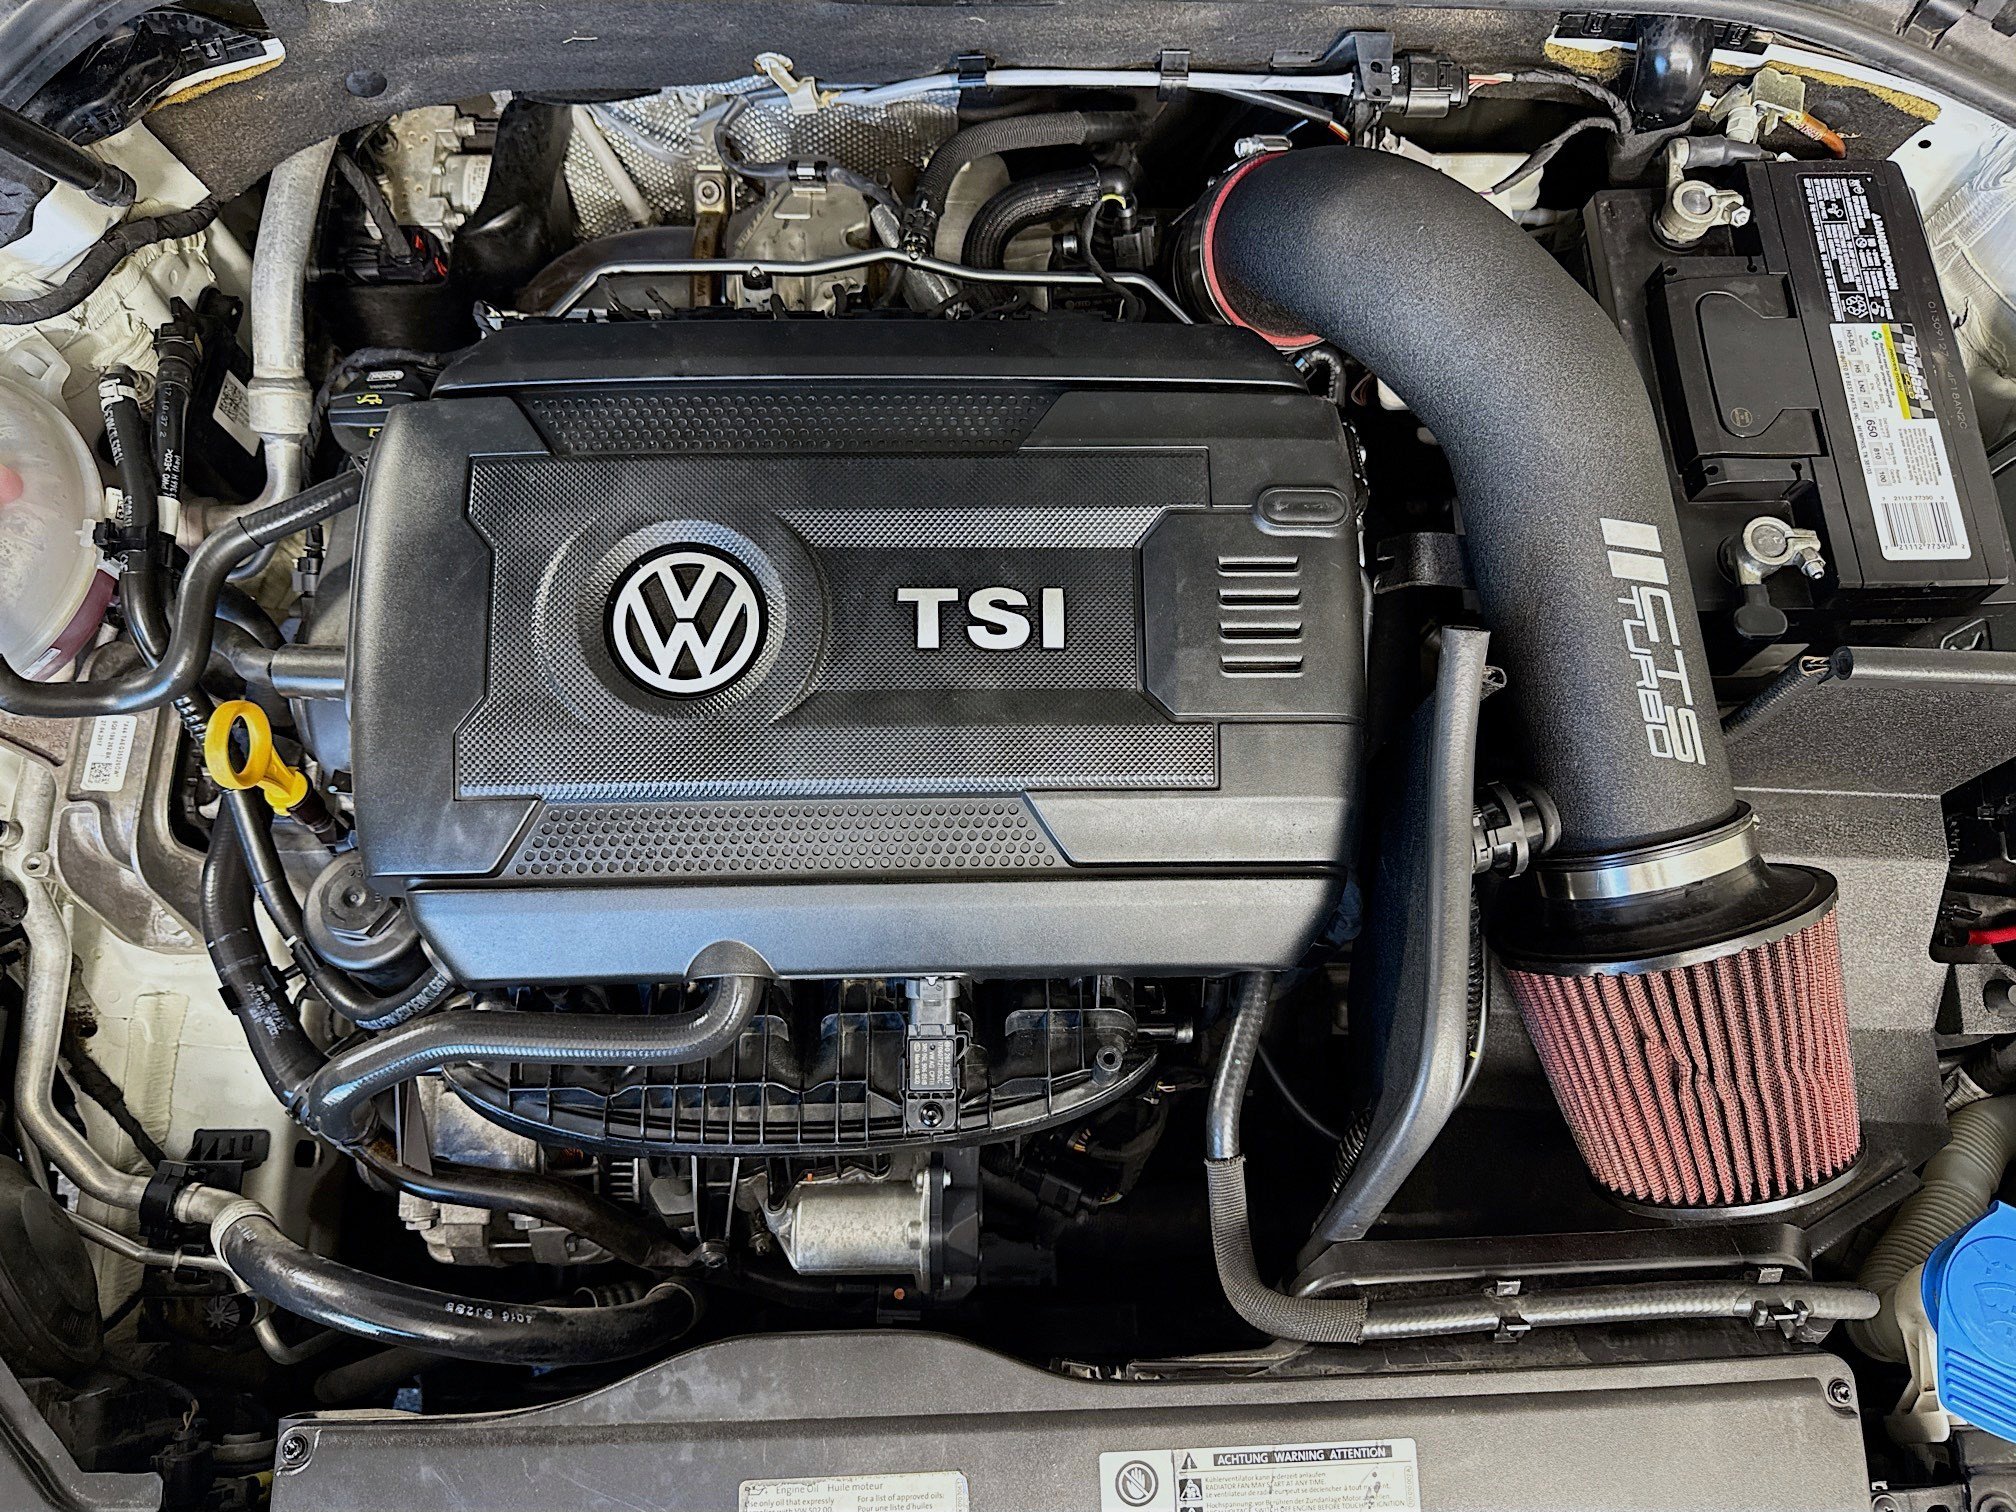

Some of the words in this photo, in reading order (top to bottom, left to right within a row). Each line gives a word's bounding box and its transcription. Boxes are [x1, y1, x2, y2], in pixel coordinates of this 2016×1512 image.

[1900, 340, 1929, 400] Duralast
[1845, 380, 1853, 391] BEST
[1857, 380, 1866, 392] LN2
[1902, 372, 1915, 399] GOLD
[1865, 419, 1879, 437] 650
[1872, 447, 1881, 459] 810
[1878, 471, 1887, 482] 100
[612, 552, 760, 693] VW
[897, 588, 1066, 649] TSI
[1617, 585, 1673, 758] TURBO
[1639, 586, 1707, 766] CTS
[1217, 1453, 1268, 1465] ACHTUNG
[1274, 1450, 1325, 1463] WARNING
[1329, 1447, 1387, 1460] ATTENTION
[776, 1485, 806, 1497] Engine
[807, 1483, 819, 1493] Oil
[827, 1483, 850, 1492] Huile
[852, 1482, 884, 1491] moteur
[760, 1499, 774, 1508] only
[775, 1498, 784, 1506] oil
[786, 1498, 801, 1506] that
[802, 1497, 835, 1506] expressly
[875, 1494, 886, 1502] list
[896, 1493, 929, 1502] approved
[890, 1503, 904, 1511] liste
